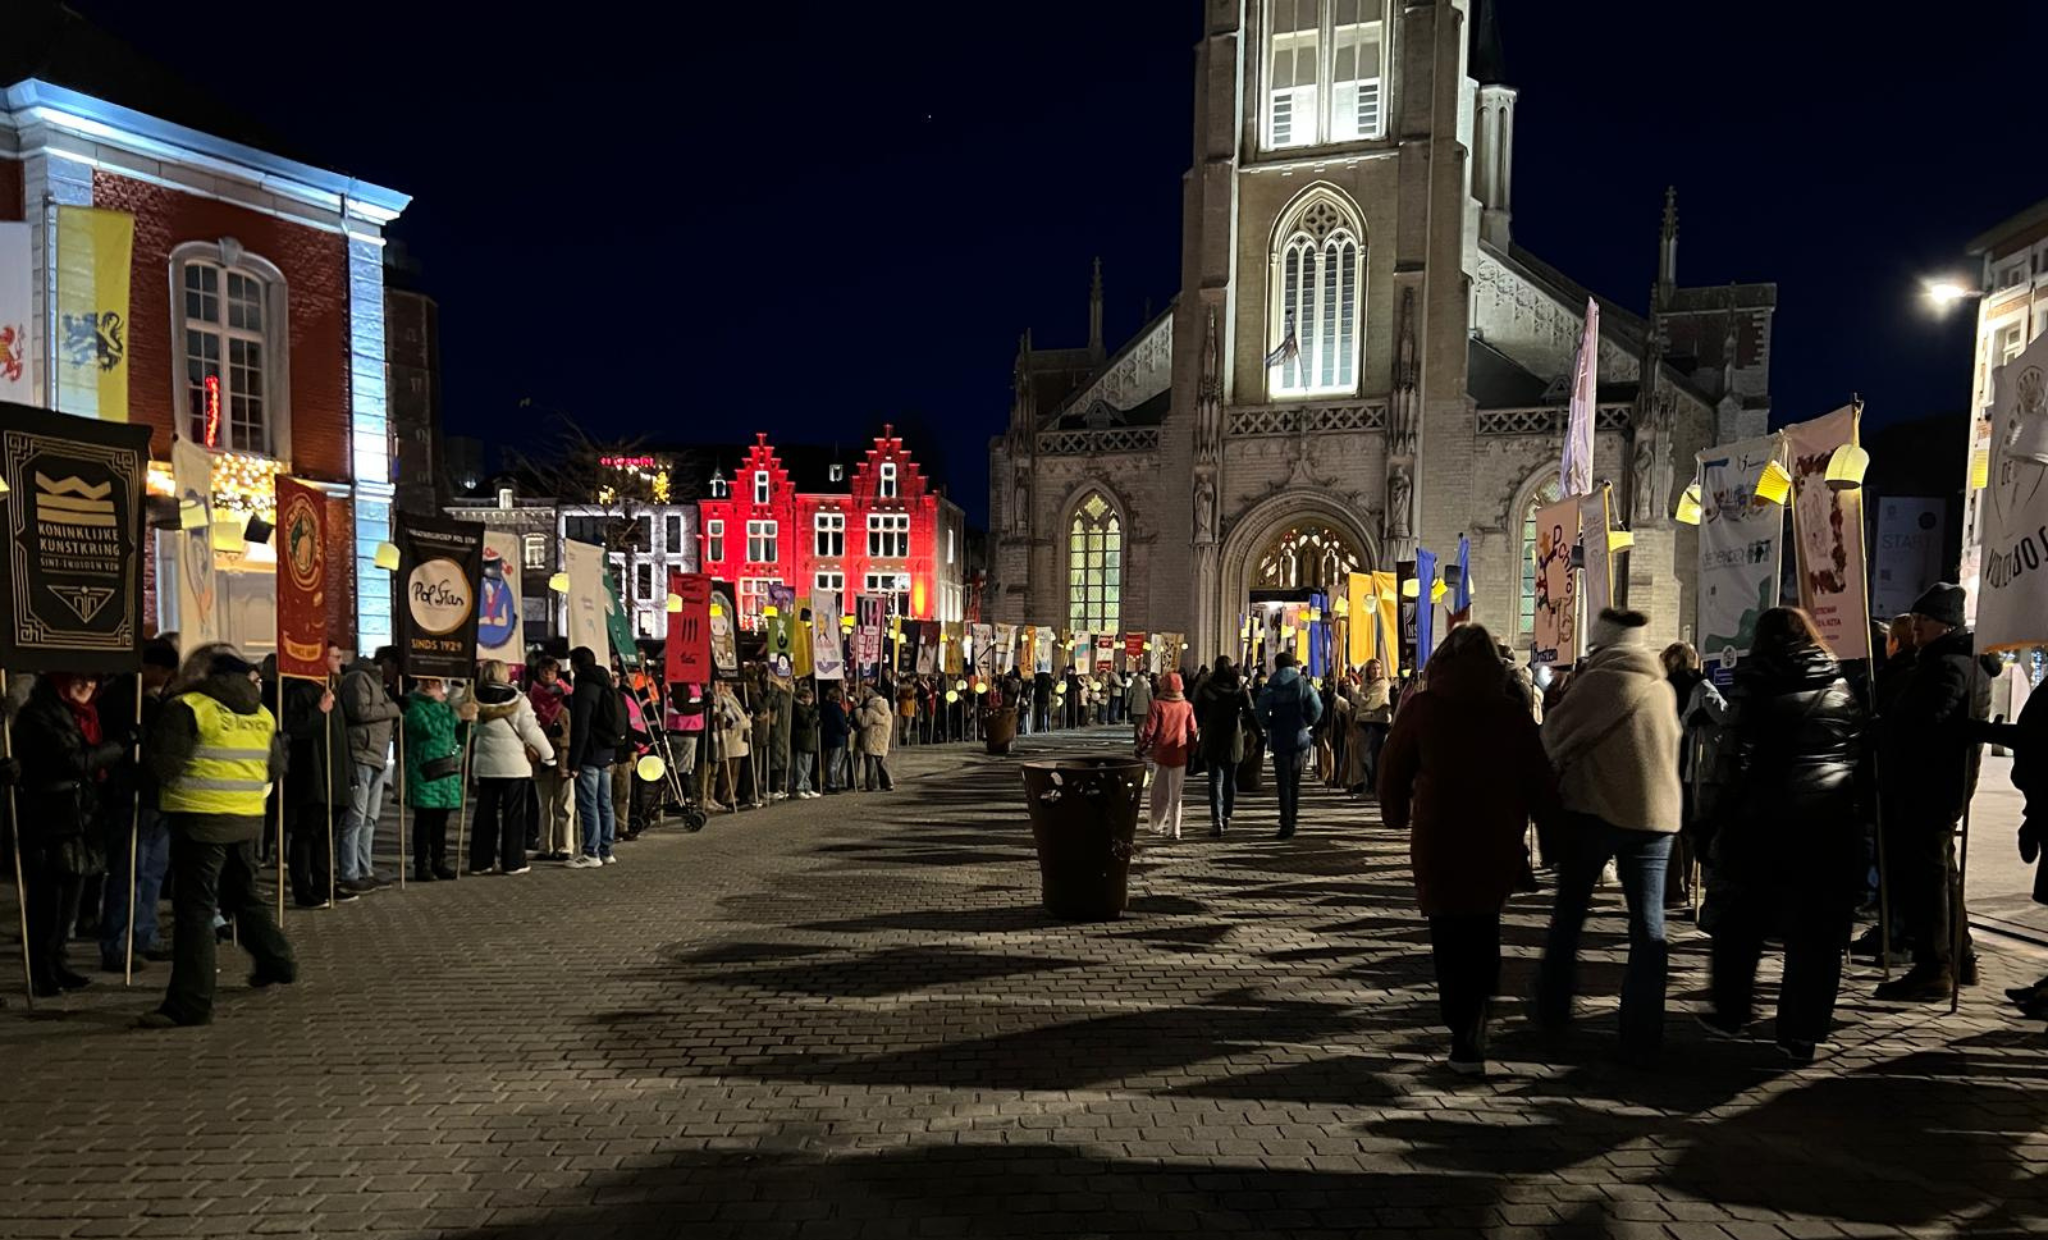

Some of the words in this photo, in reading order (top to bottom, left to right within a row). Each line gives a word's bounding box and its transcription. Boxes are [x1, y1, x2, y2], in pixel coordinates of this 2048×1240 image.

[38, 522, 119, 541] KONINKLIJKE
[40, 538, 120, 557] KUNSTKRING
[411, 581, 436, 606] Pol
[436, 579, 465, 606] Stan
[411, 638, 438, 650] SINDS
